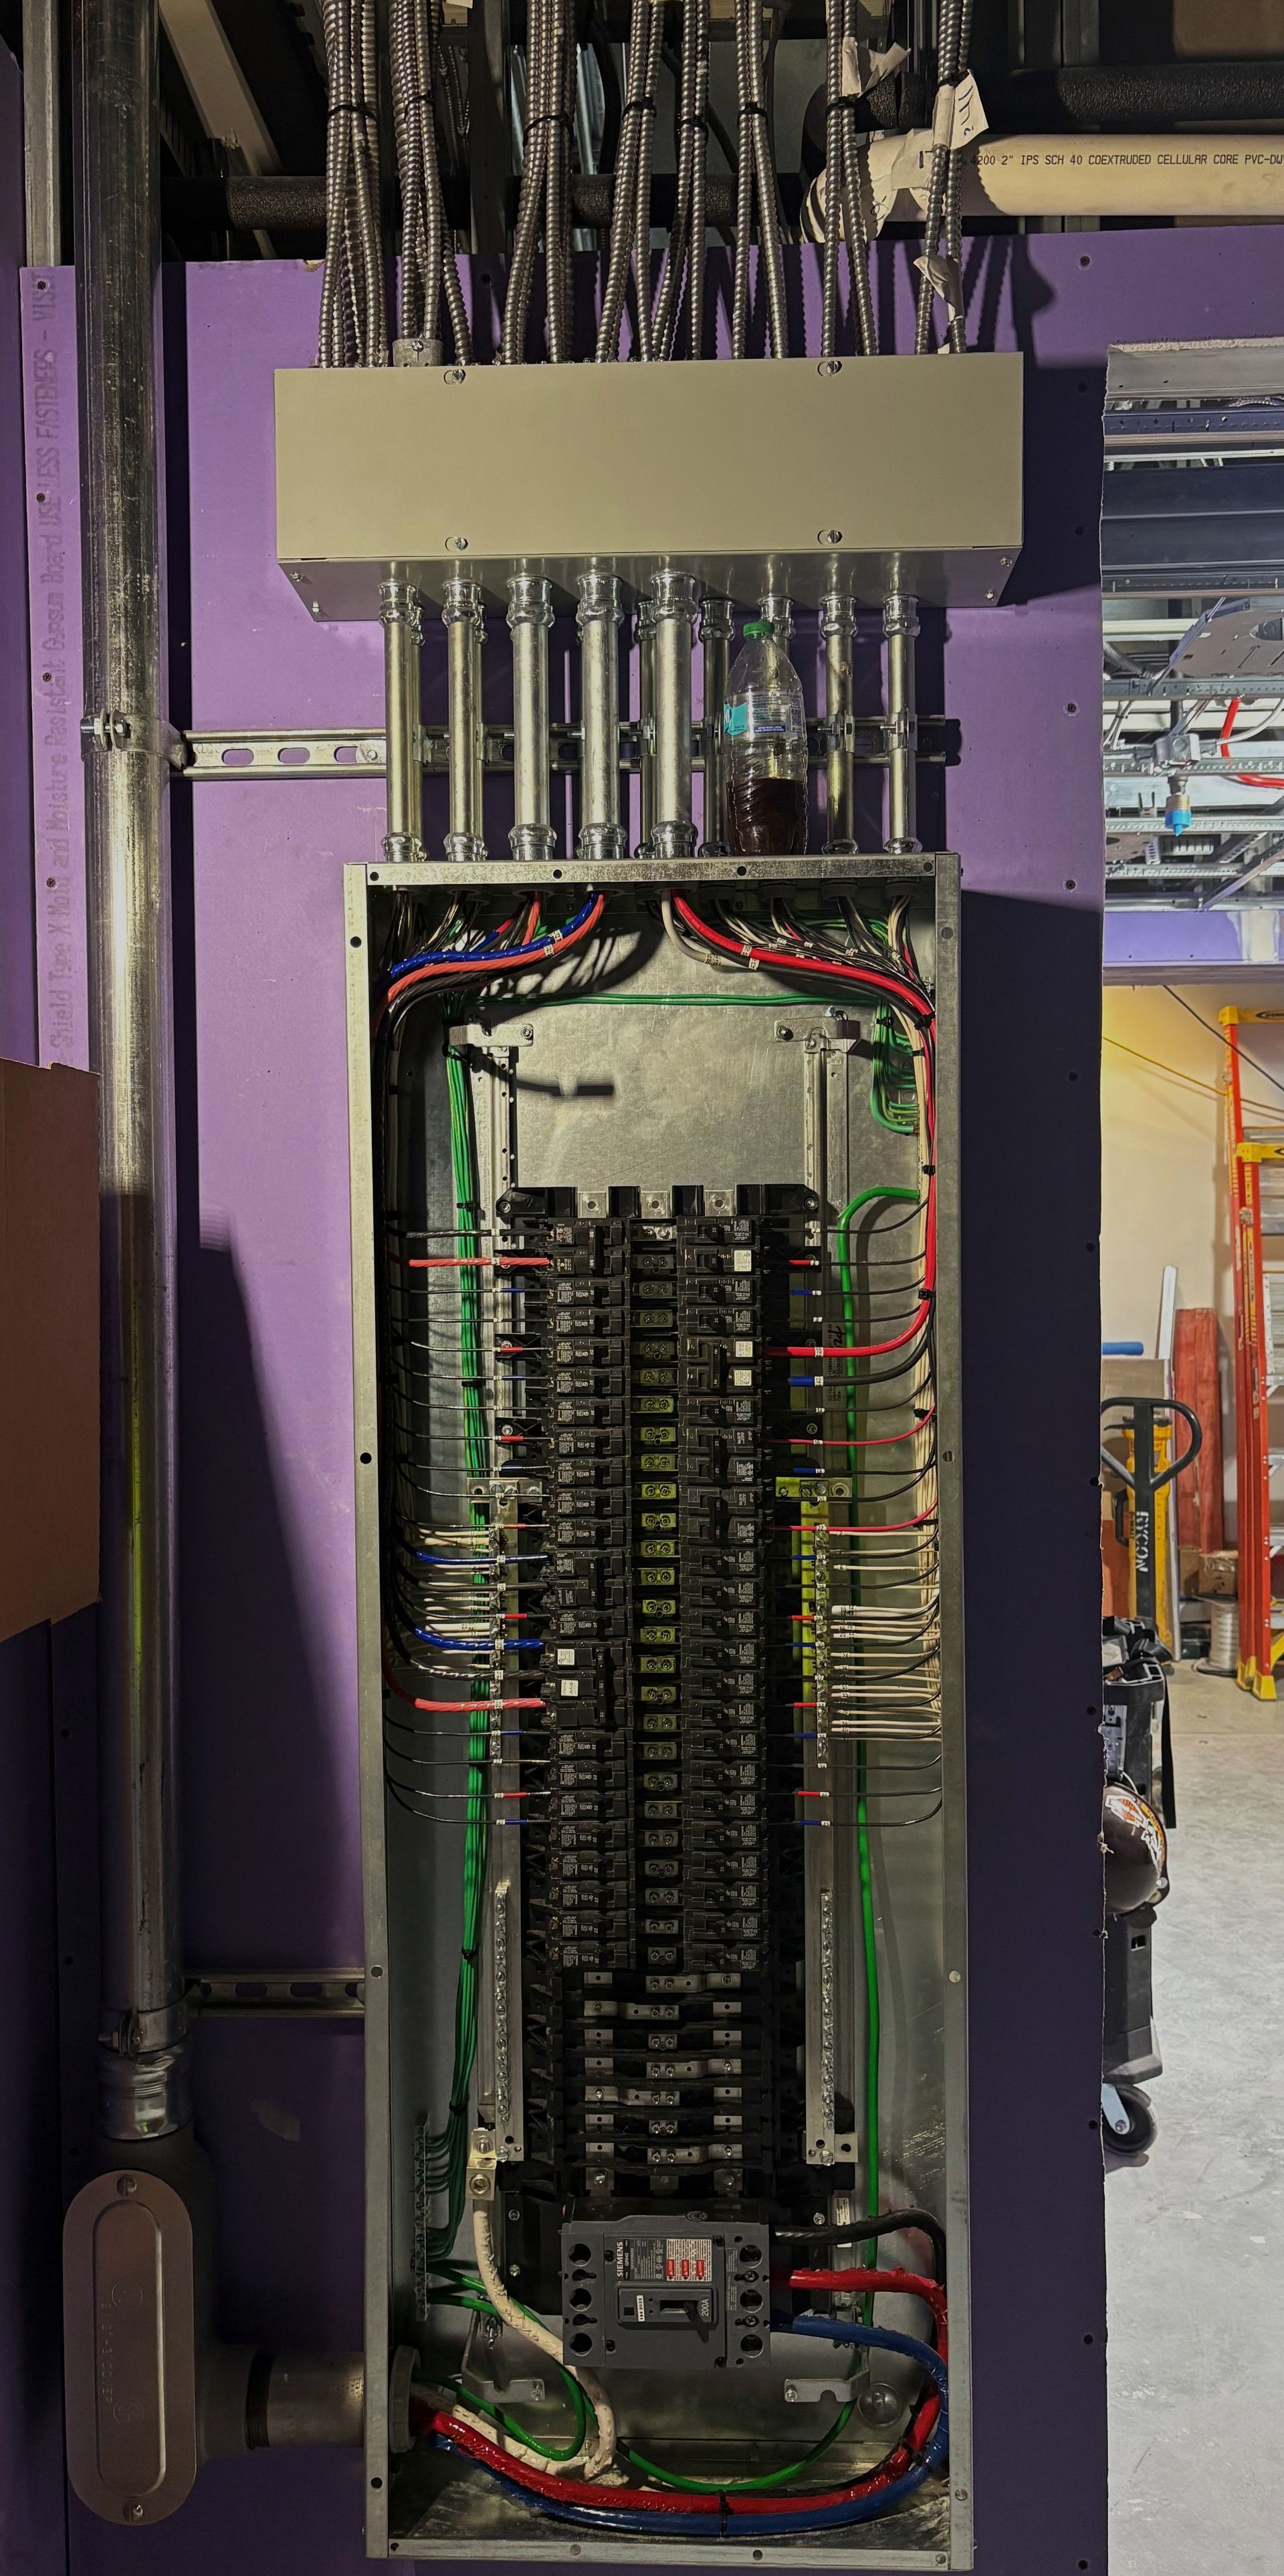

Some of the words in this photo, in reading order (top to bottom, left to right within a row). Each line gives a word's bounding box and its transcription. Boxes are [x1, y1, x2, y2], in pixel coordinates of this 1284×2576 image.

[971, 154, 996, 166] 4200
[1001, 154, 1014, 165] 2"
[1021, 154, 1039, 166] IPS
[1045, 154, 1064, 166] SCH
[1070, 154, 1083, 165] 40
[1088, 154, 1152, 165] COEXTRUDED
[1157, 154, 1207, 165] CELLULAR
[1213, 154, 1239, 165] CORE
[1244, 154, 1284, 165] PVC-DW
[33, 348, 60, 439] FASTENERS
[38, 534, 64, 584] Board
[45, 753, 69, 830] Moisture
[47, 923, 72, 936] X
[1135, 1511, 1150, 1572] RYCON
[701, 2298, 710, 2317] 200A
